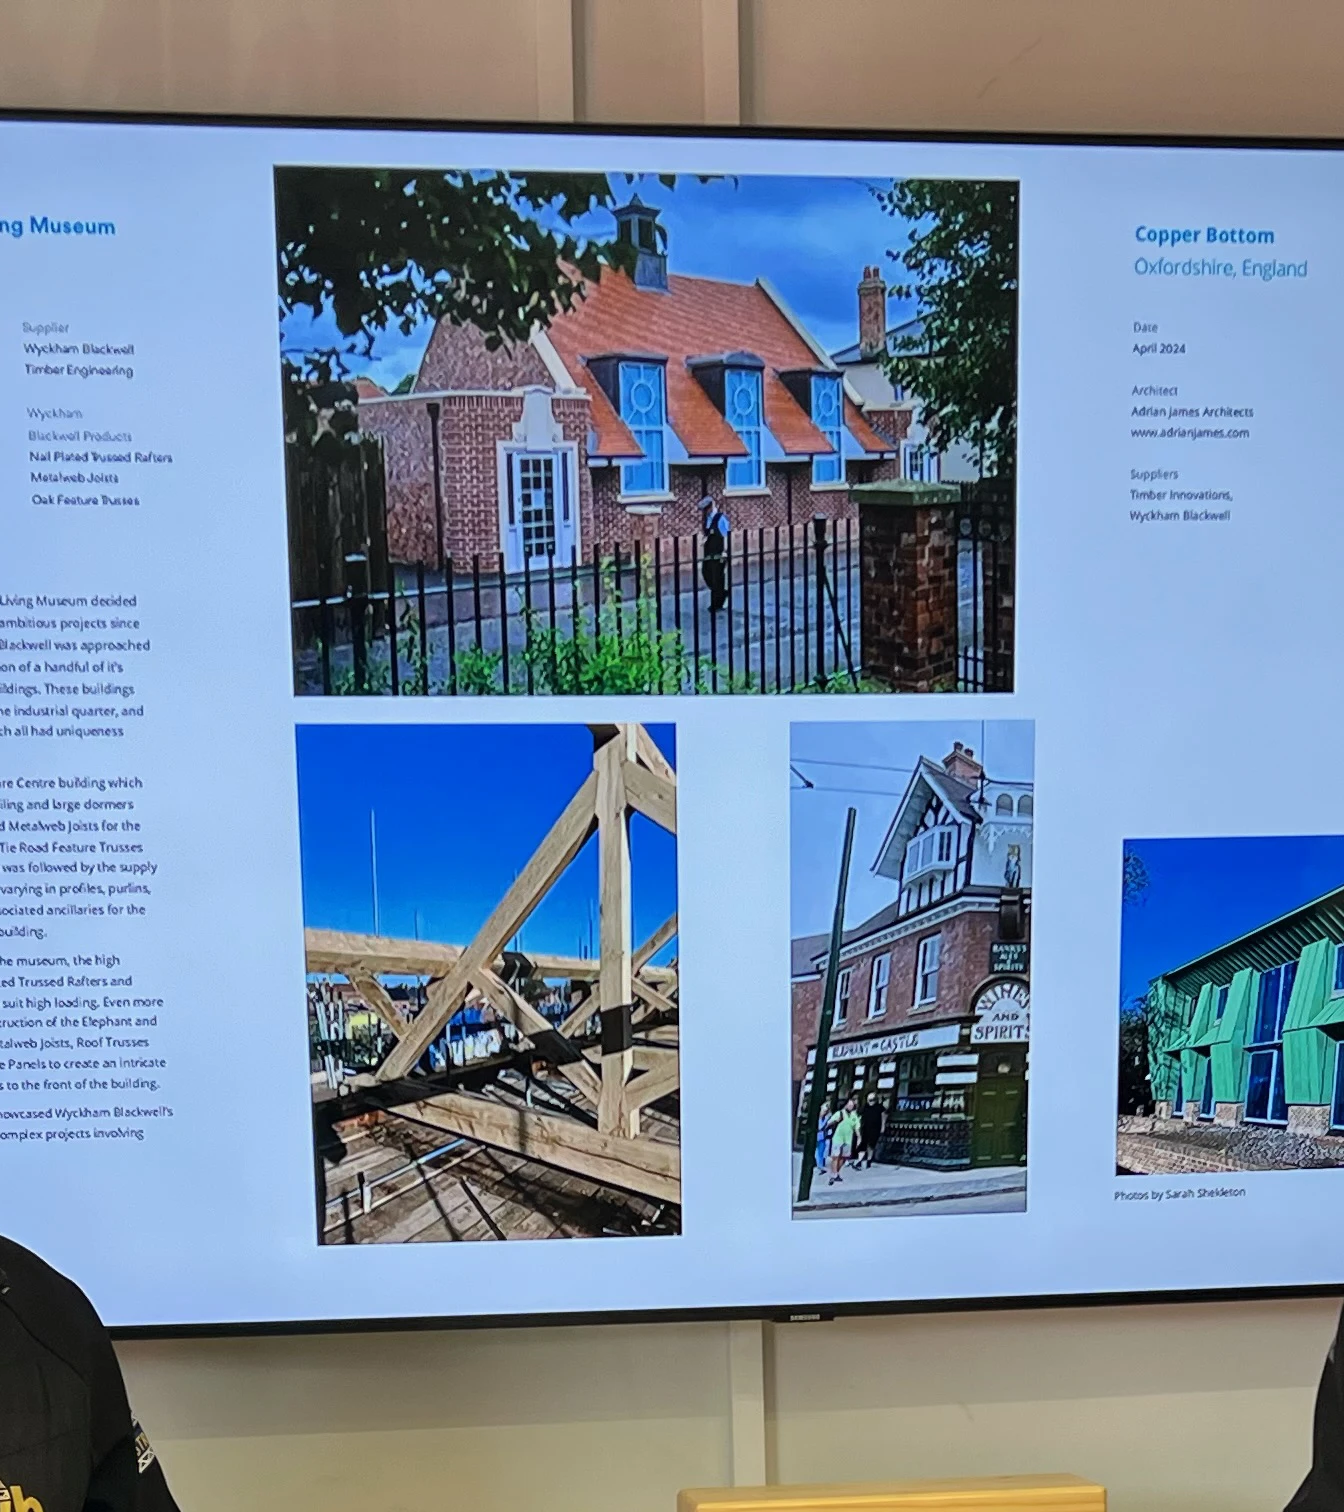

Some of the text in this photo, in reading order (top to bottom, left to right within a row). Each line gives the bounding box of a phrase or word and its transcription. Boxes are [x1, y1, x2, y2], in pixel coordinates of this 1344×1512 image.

[30, 215, 116, 235] Museum
[1135, 226, 1275, 247] Copper Bottom
[1134, 257, 1308, 282] Oxfordshire, England
[21, 321, 70, 337] Supplier
[1133, 322, 1159, 334] Date
[23, 342, 135, 357] Wyckham Blackwell
[1132, 343, 1186, 357] April 2024
[24, 363, 134, 379] Timber Engineering
[1131, 385, 1178, 397] Architect
[26, 407, 83, 422] Wyckham
[1130, 406, 1254, 420] Adrian James Architects
[28, 430, 133, 443] Blackwell Products
[29, 451, 52, 462] Nail
[134, 451, 173, 464] Rafters
[1130, 468, 1179, 483] Suppliers
[31, 494, 55, 505] Oak
[56, 494, 99, 506] Feature
[1129, 489, 1234, 502] Timber Innovations,
[1129, 509, 1231, 524] Wyckham Blackwell
[35, 595, 88, 607] Museum
[90, 594, 137, 607] decided
[1151, 1190, 1164, 1202] by
[1165, 1189, 1195, 1200] Sarah
